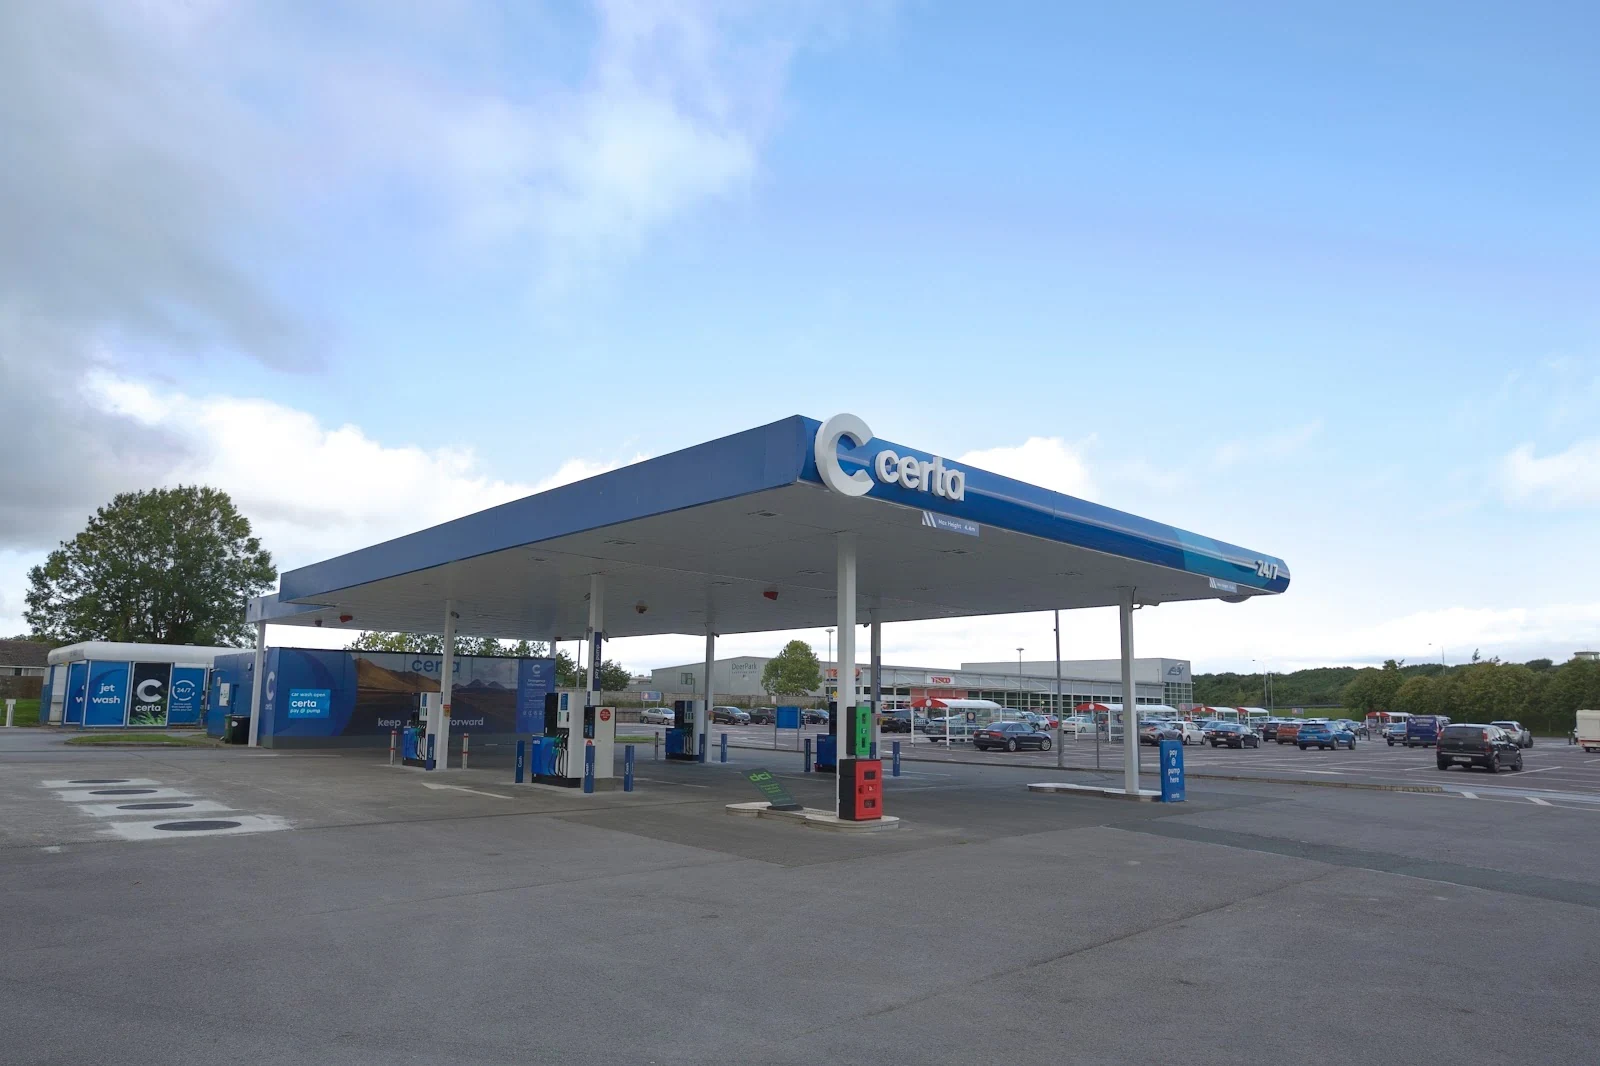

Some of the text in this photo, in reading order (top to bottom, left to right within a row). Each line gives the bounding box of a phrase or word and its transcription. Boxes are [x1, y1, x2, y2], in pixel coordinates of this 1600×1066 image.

[875, 450, 965, 501] certa
[947, 521, 962, 530] Height
[1257, 560, 1279, 580] 24/7
[411, 659, 460, 673] cera
[731, 662, 757, 670] DeerPark
[930, 676, 951, 684] TESCO
[99, 682, 115, 694] jet
[92, 695, 120, 704] wash
[291, 699, 317, 708] certa
[135, 704, 161, 712] certa
[378, 717, 401, 728] keep
[449, 717, 484, 726] orward
[1169, 749, 1178, 758] pay
[1168, 768, 1180, 776] pump
